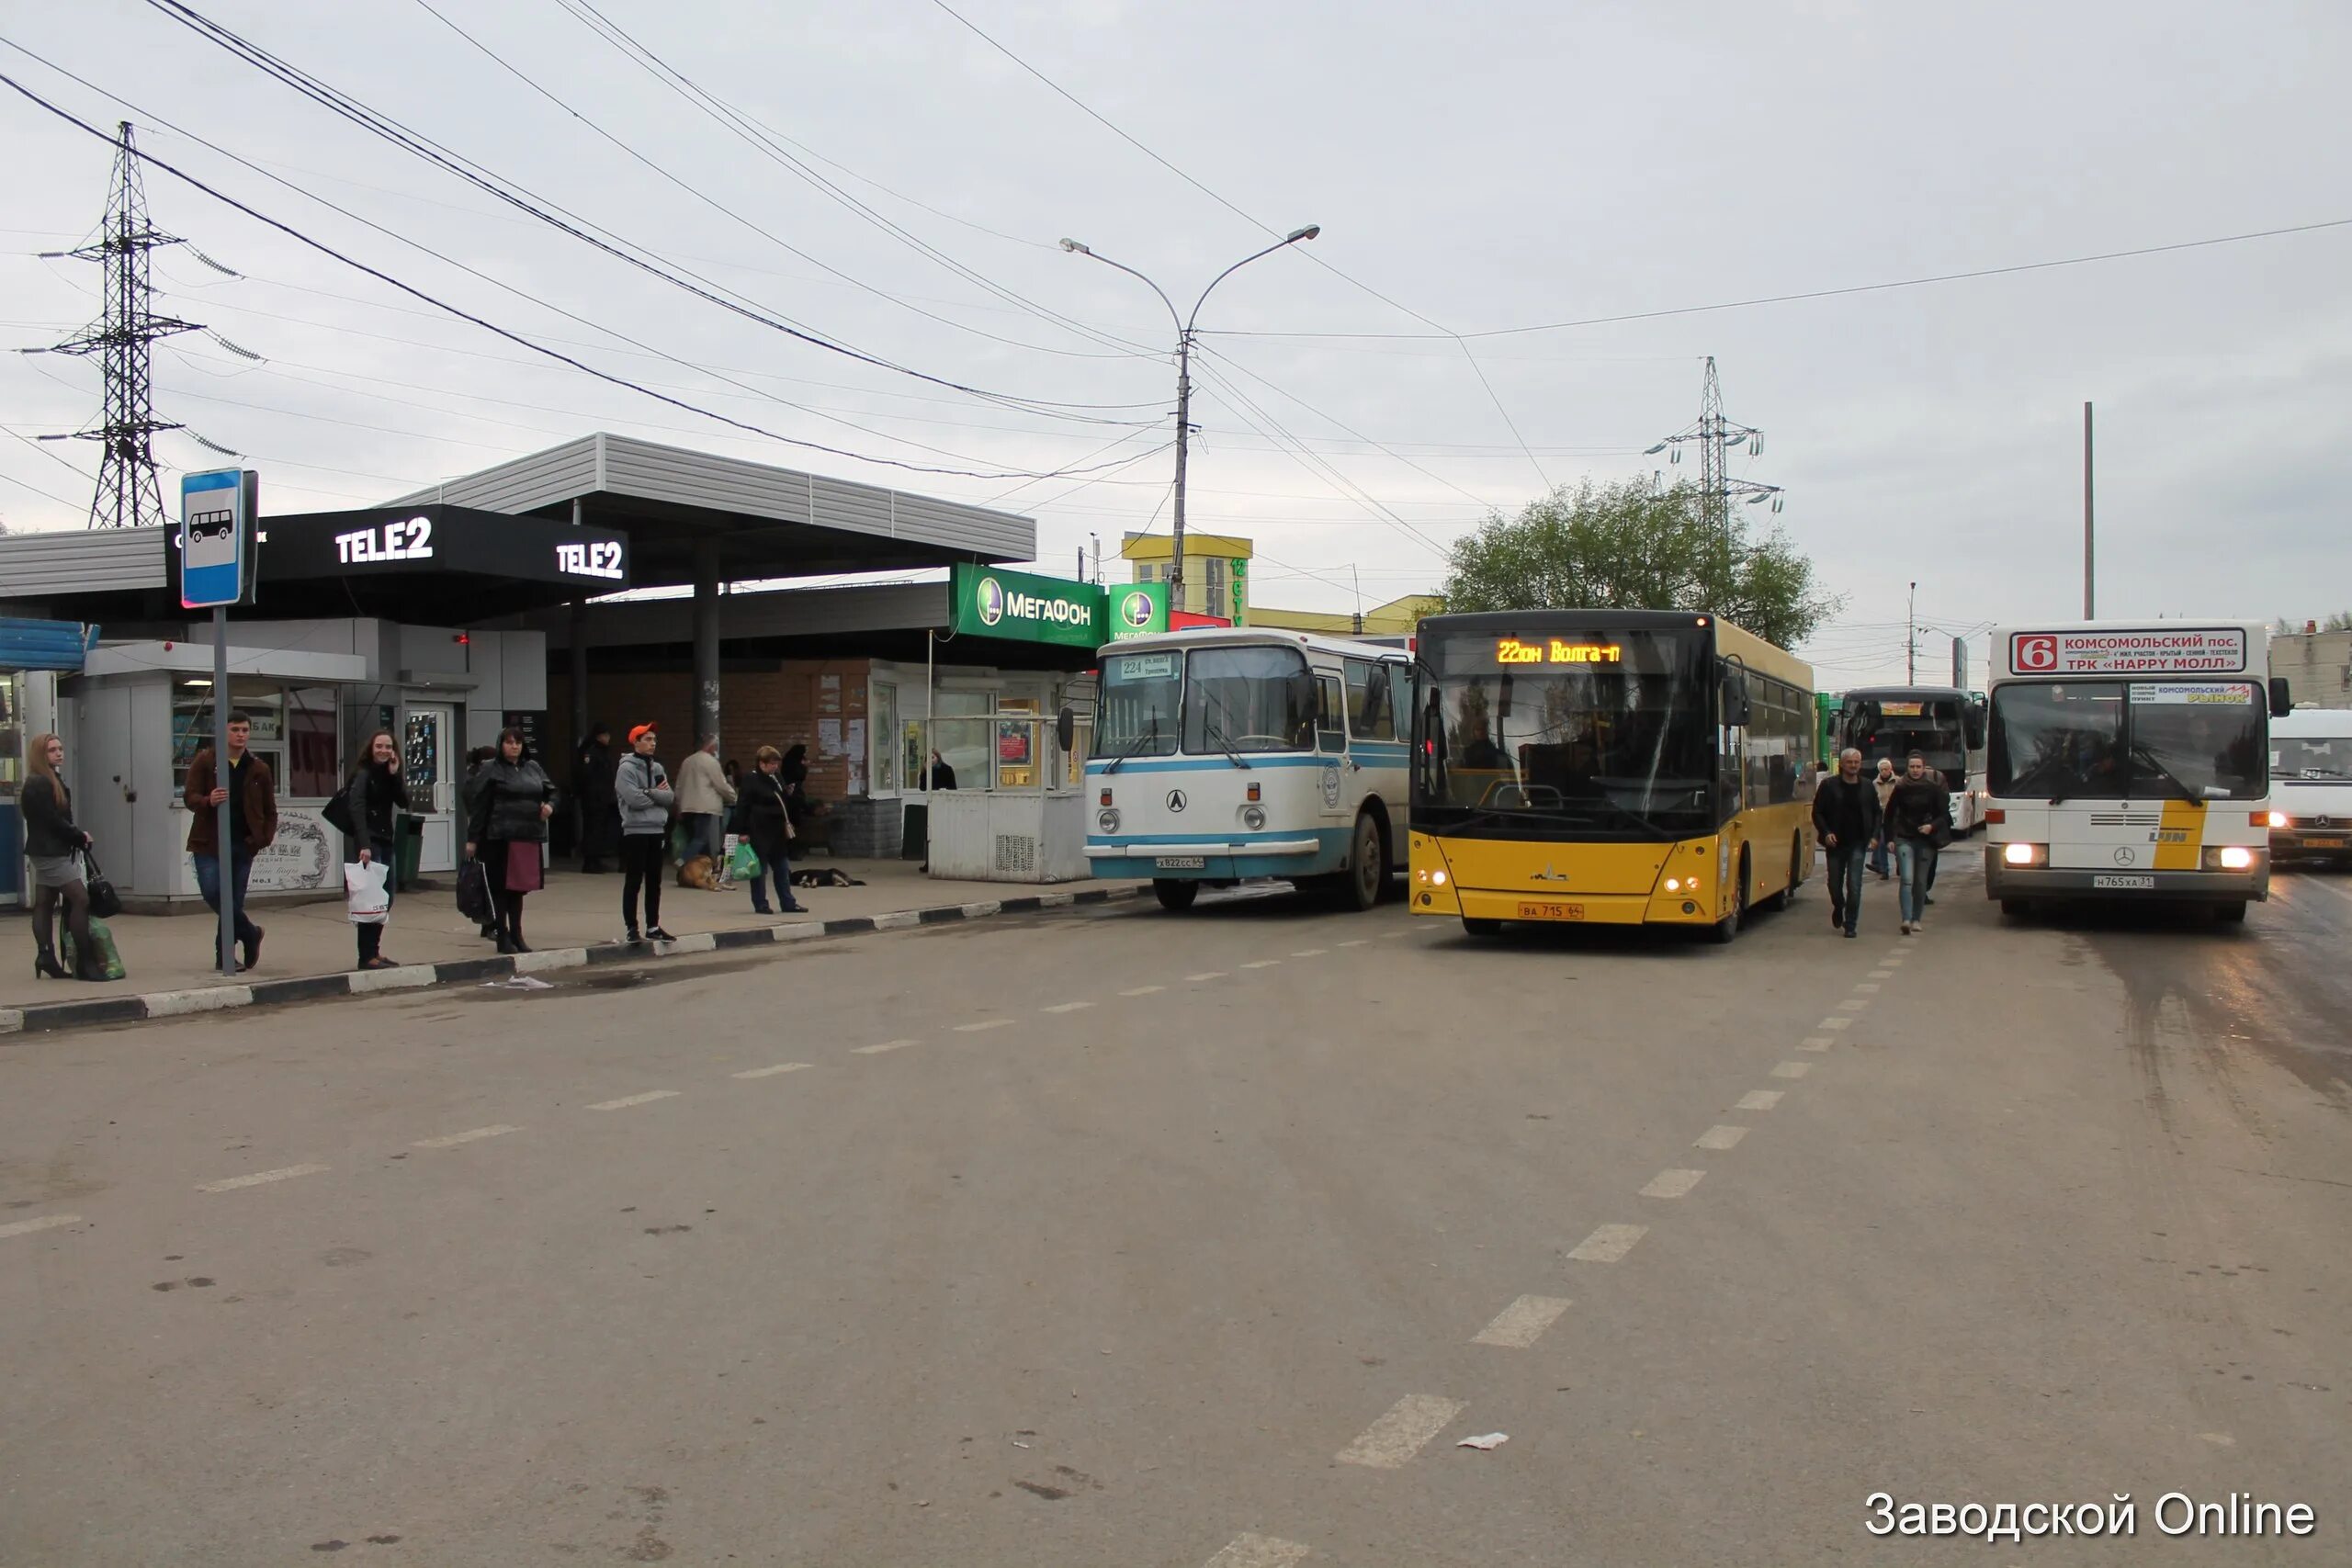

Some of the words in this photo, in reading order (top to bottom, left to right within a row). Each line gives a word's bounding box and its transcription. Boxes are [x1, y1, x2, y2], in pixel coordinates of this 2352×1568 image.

[334, 516, 433, 564] TELE2
[556, 541, 623, 580] TELE2
[2064, 634, 2203, 649] КОМСОМОЛЬСКИЙ
[2021, 638, 2054, 668] 6
[2066, 660, 2098, 670] ТРК
[2187, 694, 2247, 704] РЫНОК
[250, 722, 276, 731] БАК
[1544, 906, 1562, 917] 715
